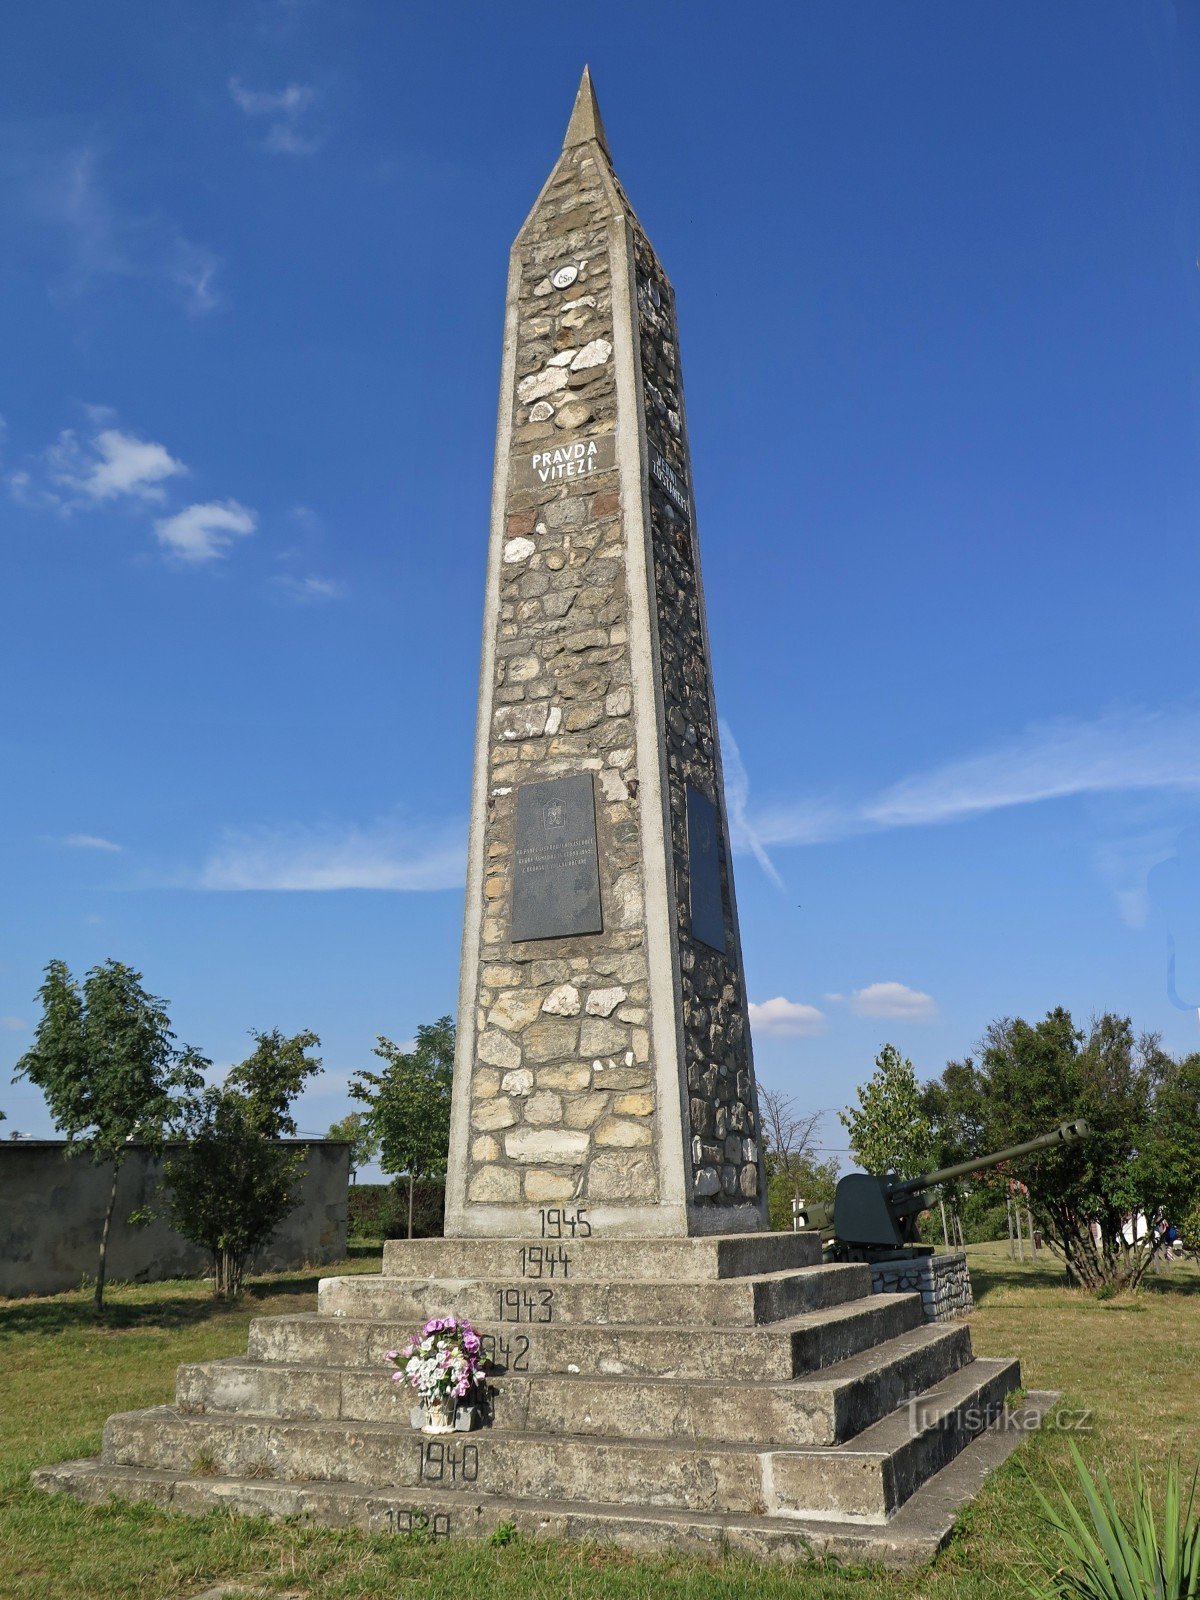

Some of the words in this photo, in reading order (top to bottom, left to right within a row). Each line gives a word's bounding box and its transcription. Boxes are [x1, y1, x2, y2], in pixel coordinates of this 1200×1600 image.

[532, 441, 598, 469] PRAVDA
[539, 1209, 592, 1239] 1945
[518, 1246, 572, 1279] 1944
[497, 1289, 554, 1323] 1943
[481, 1335, 530, 1371] 942
[417, 1442, 478, 1481] 1940
